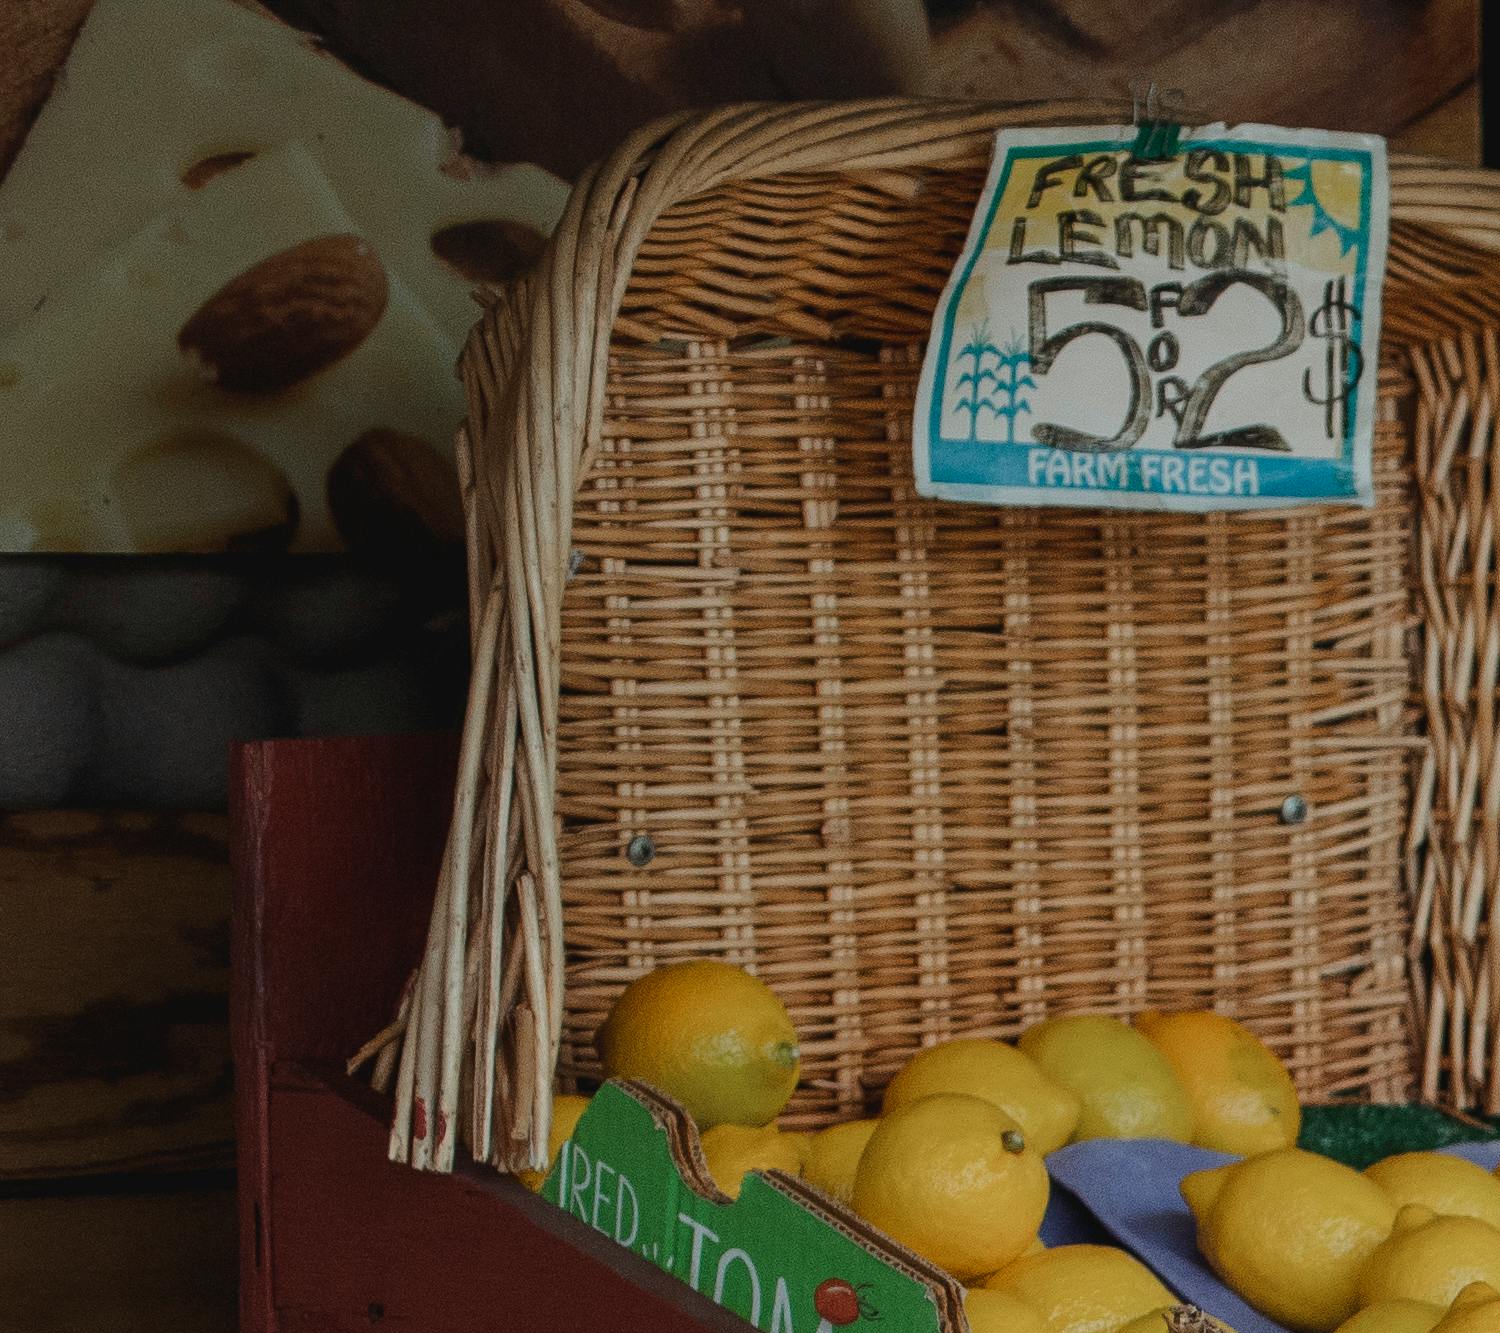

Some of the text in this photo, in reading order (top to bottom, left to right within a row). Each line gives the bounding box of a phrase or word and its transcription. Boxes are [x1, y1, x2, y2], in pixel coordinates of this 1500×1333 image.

[1027, 151, 1288, 215] FRESH
[1007, 209, 1286, 270] LEMON
[1027, 276, 1150, 453] 5
[1028, 454, 1259, 495] FARM FRESH
